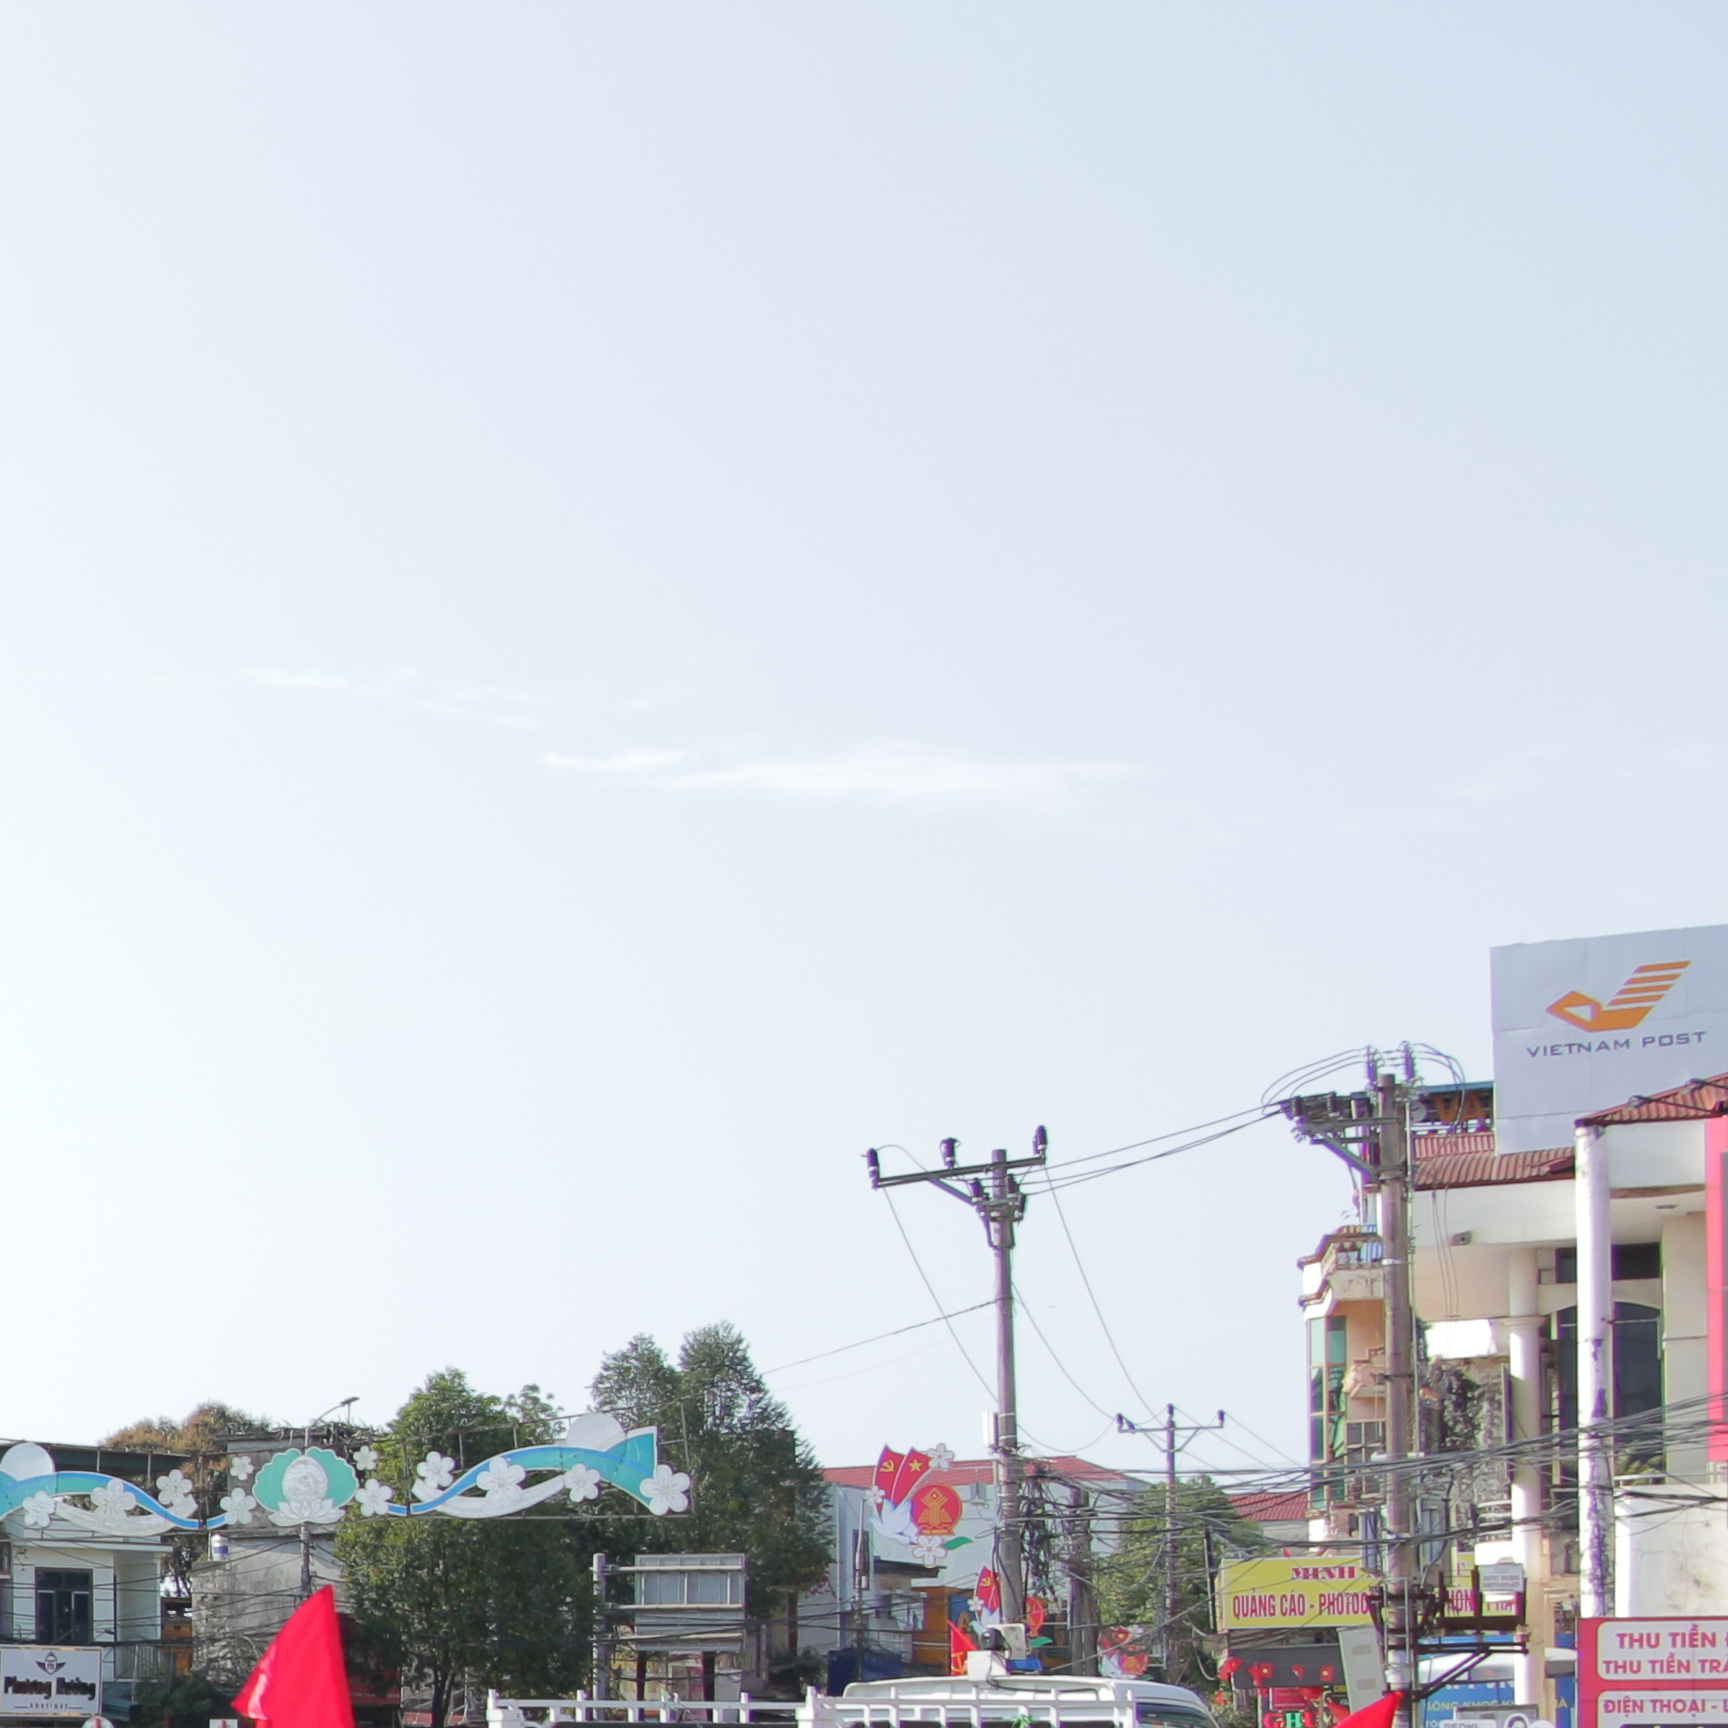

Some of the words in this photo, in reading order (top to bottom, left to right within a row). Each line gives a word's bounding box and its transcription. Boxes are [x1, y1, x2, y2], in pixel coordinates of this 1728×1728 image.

[1526, 1039, 1630, 1058] VIETNAM
[1642, 1031, 1707, 1048] POST
[1291, 1566, 1356, 1580] MINH
[1232, 1587, 1277, 1618] QUẢNG
[1280, 1589, 1305, 1617] CÁO
[1615, 1632, 1660, 1649] THU
[1668, 1623, 1717, 1649] TIỀN
[1602, 1660, 1642, 1674] THU
[1648, 1652, 1691, 1674] TIỀN
[1603, 1695, 1644, 1718] ĐIỆN
[1650, 1699, 1706, 1718] THOẠI
